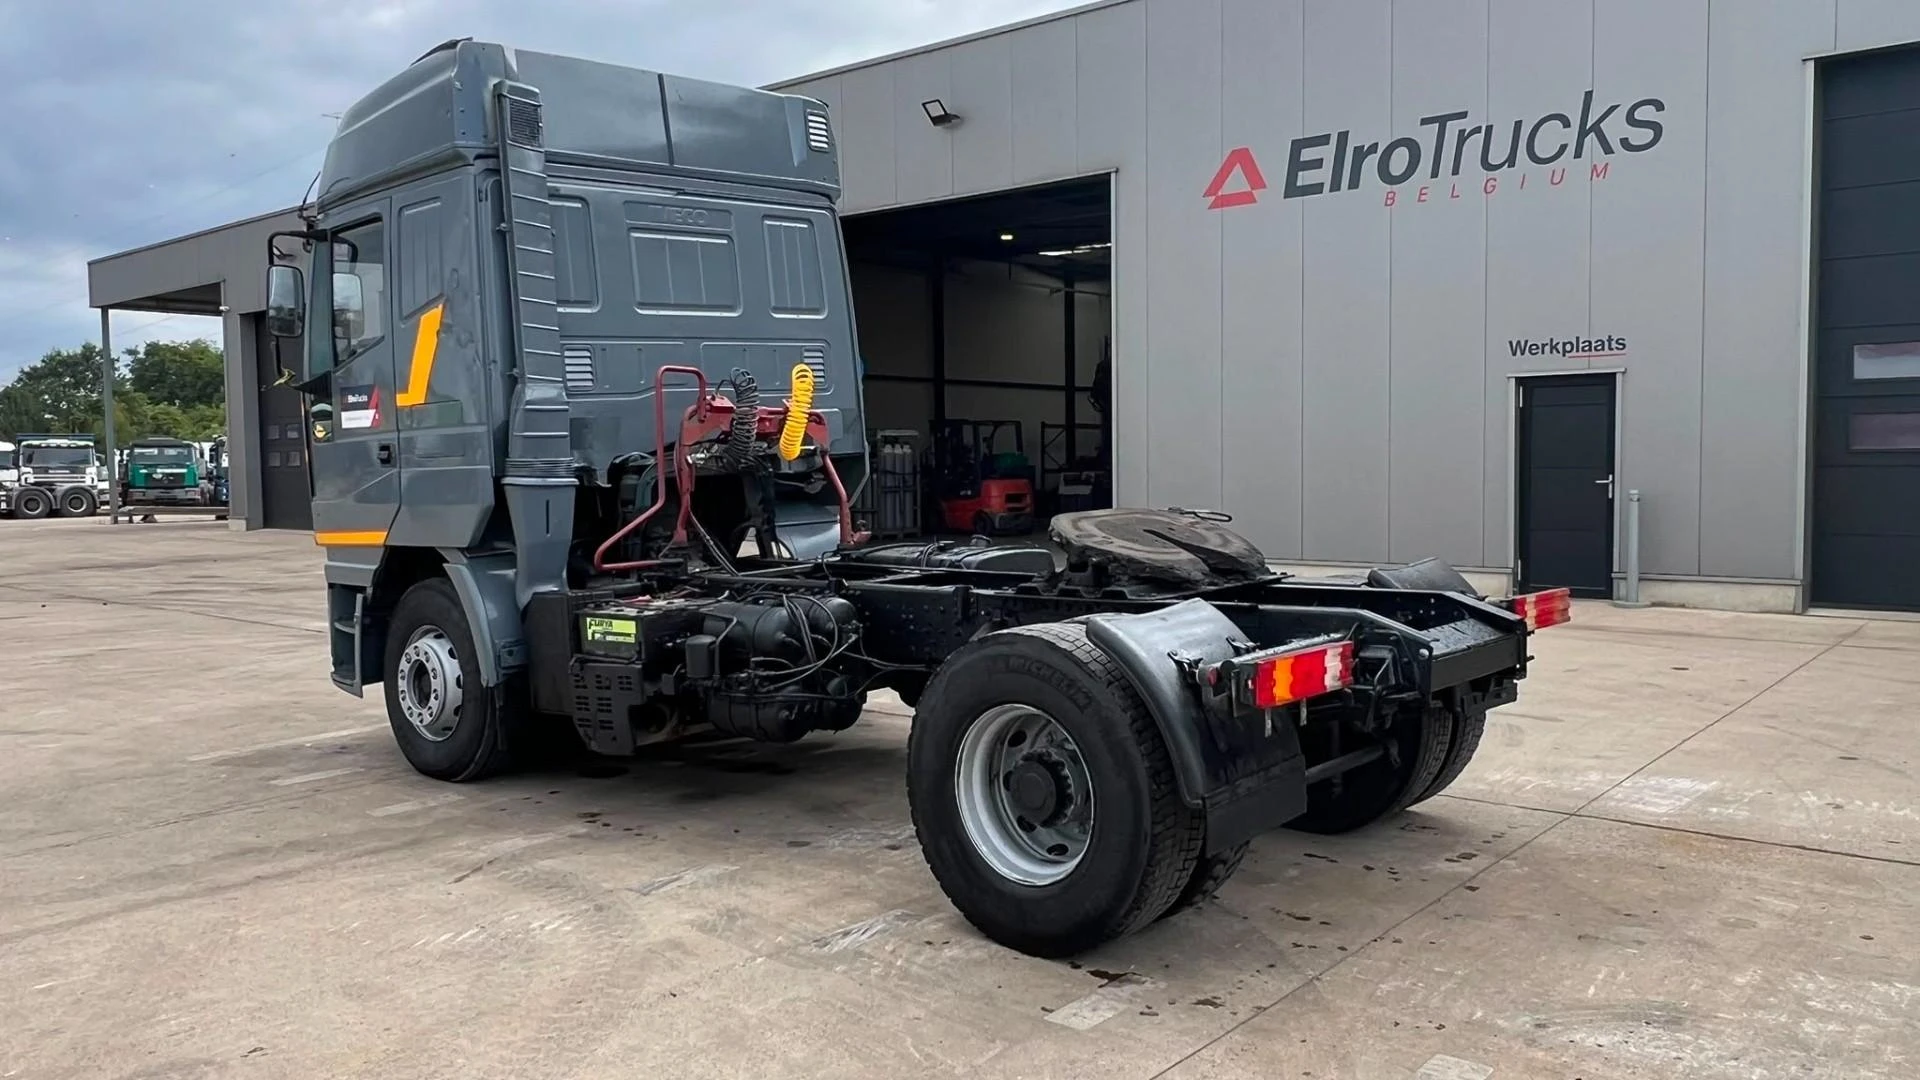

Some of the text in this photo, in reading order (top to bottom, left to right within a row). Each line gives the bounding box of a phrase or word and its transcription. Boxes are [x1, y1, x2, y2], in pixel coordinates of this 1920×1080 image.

[1283, 89, 1666, 199] ElroTrucks
[1384, 162, 1610, 207] BELGIUM
[1508, 334, 1627, 357] Werkplaats
